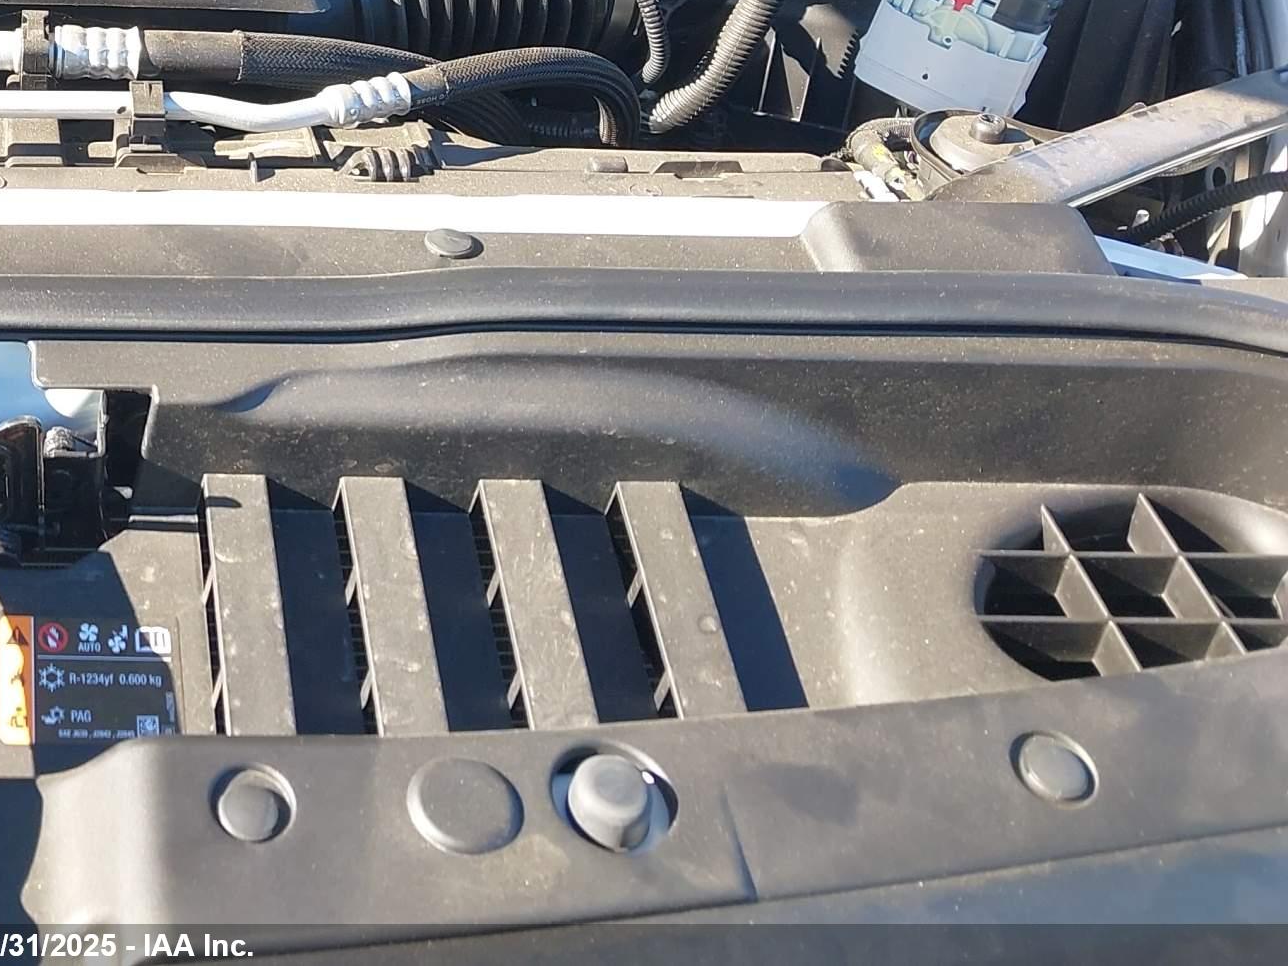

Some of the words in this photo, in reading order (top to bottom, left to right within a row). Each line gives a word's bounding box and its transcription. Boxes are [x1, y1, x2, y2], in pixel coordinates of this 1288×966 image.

[78, 642, 102, 653] AUTO
[68, 672, 114, 687] R-1234yf
[119, 673, 147, 686] 0.600
[149, 673, 162, 688] kg
[71, 709, 92, 723] PAG
